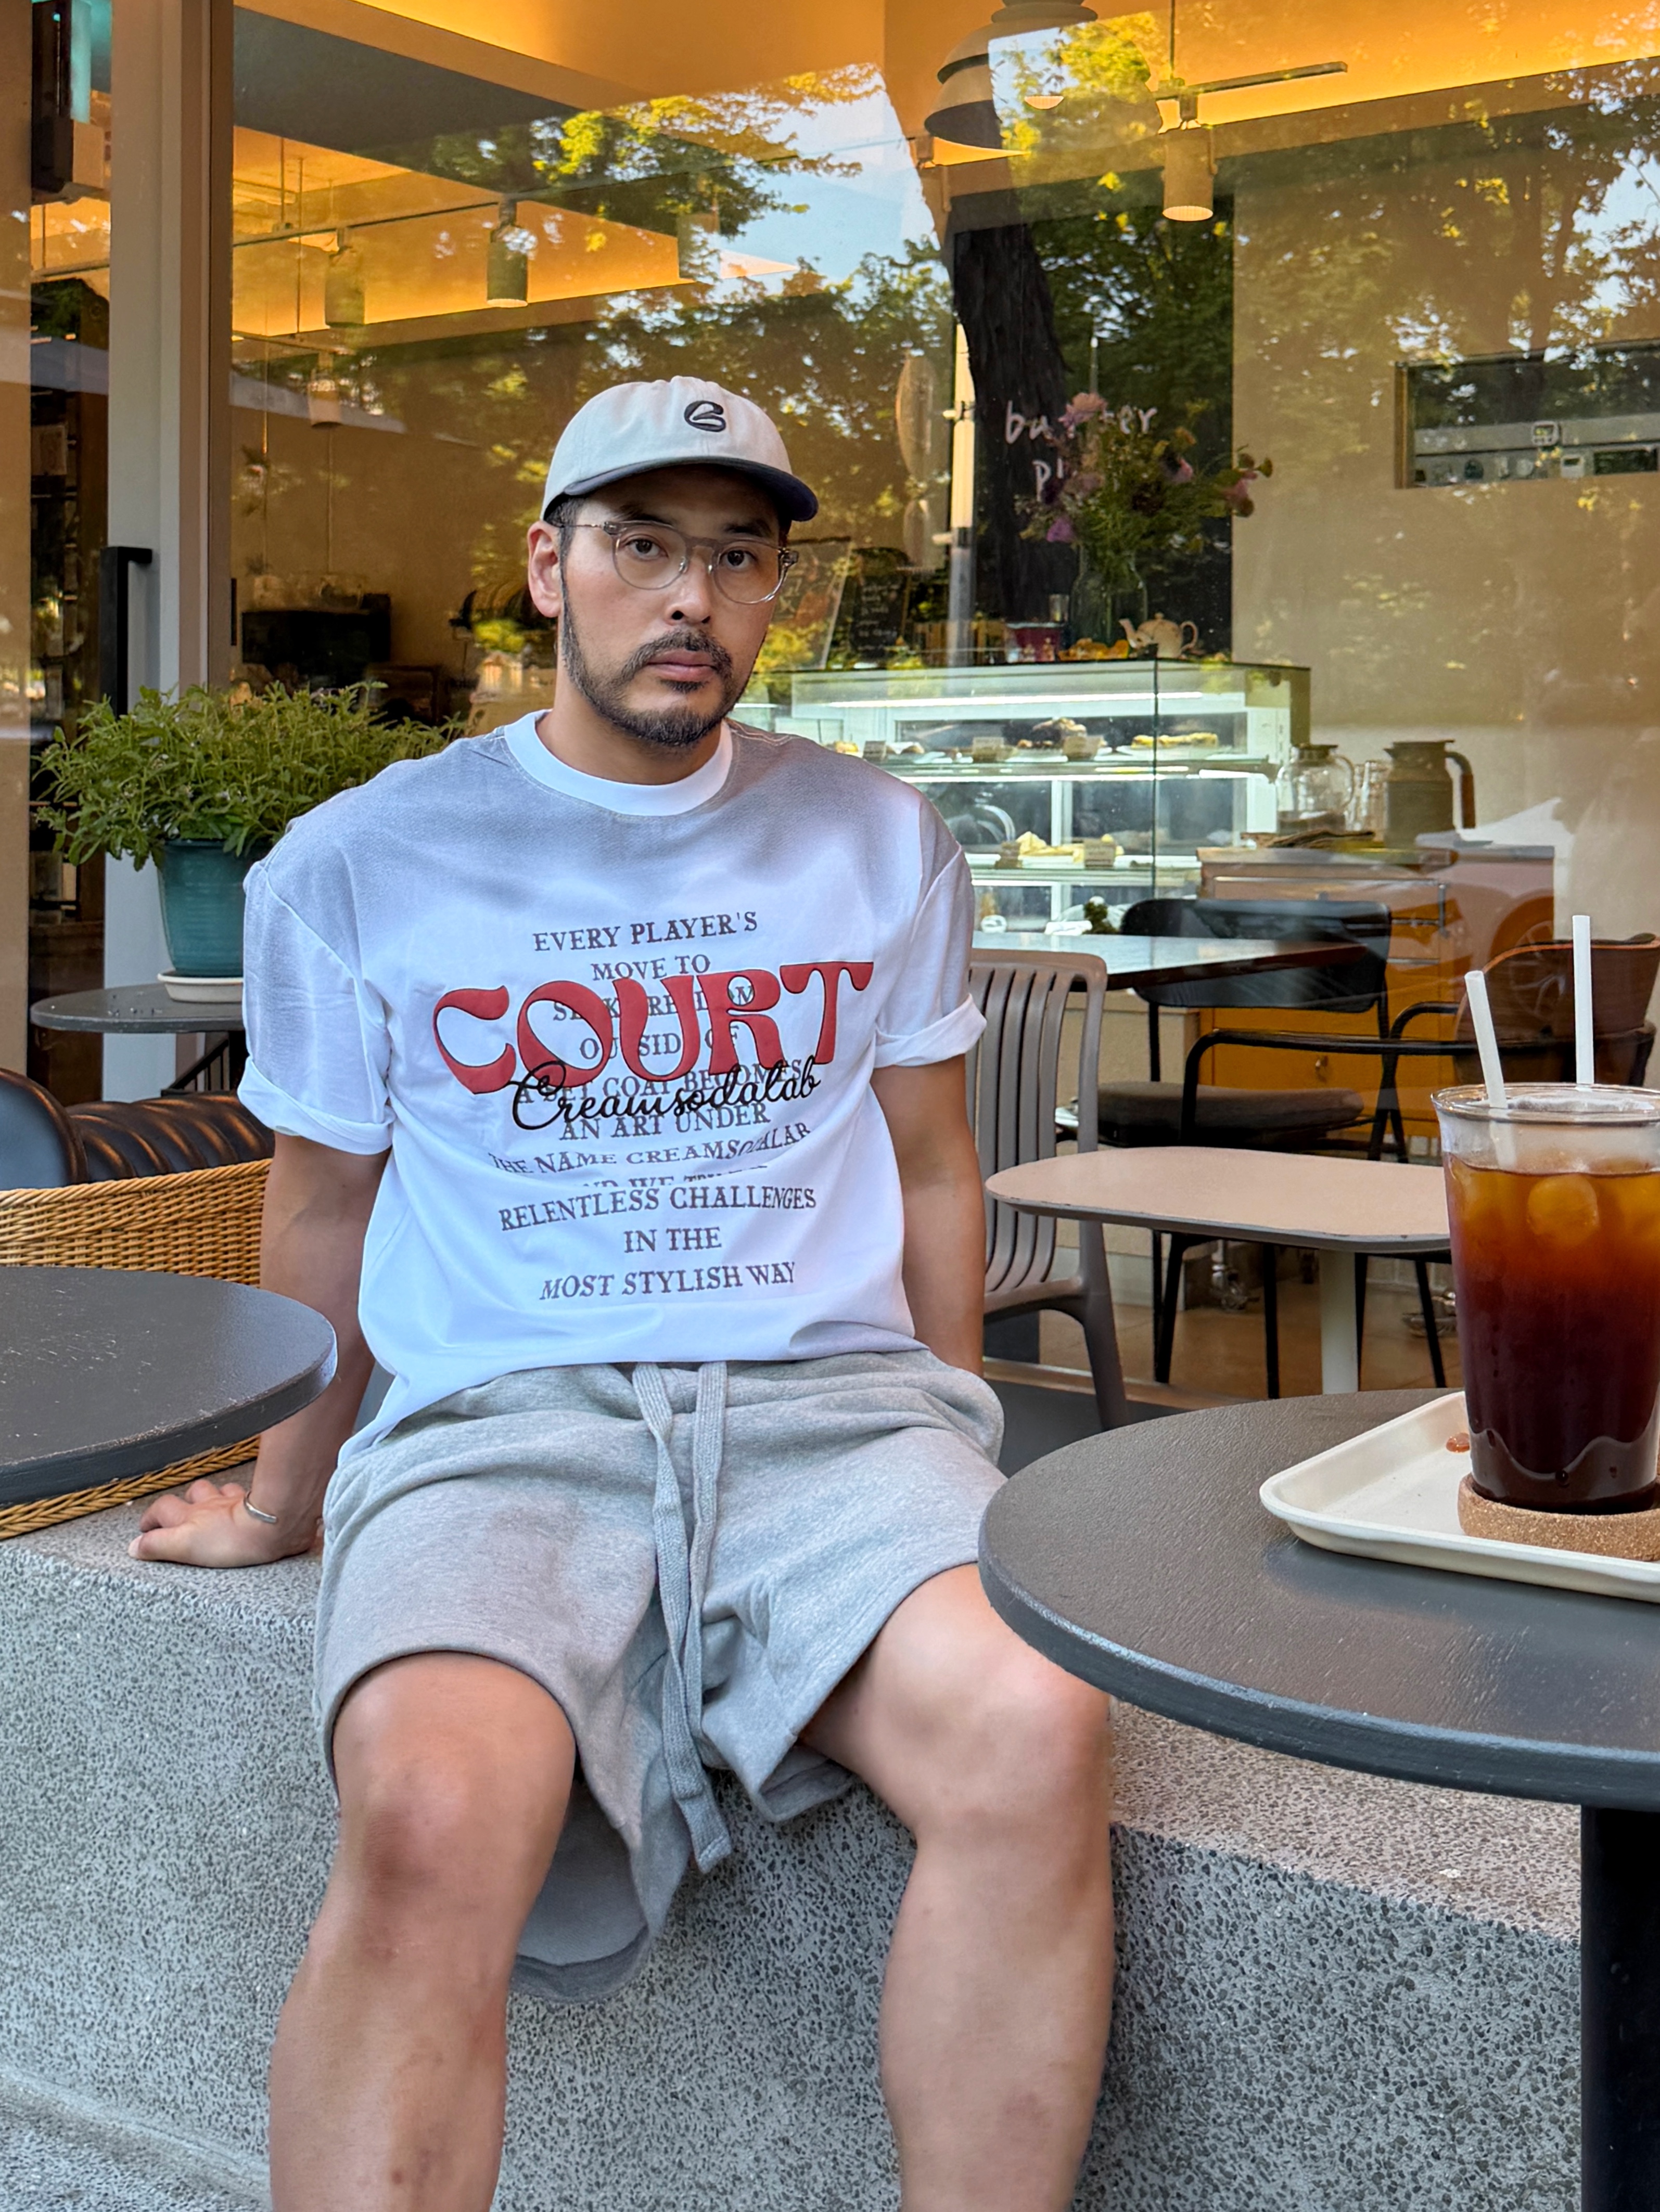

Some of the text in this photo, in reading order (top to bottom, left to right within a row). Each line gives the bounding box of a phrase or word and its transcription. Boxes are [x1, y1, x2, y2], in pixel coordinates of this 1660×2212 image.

[532, 911, 758, 951] EVERY PLAYER'S
[590, 954, 711, 981] MOVE TO
[433, 961, 874, 1095] COURT
[559, 1102, 771, 1140] AN ART UNDER
[534, 1151, 617, 1173] NAME
[498, 1186, 816, 1231] RELENTLESS CHALLENGES
[623, 1227, 722, 1253] IN THE
[539, 1262, 796, 1301] MOST STYLISH WAY
